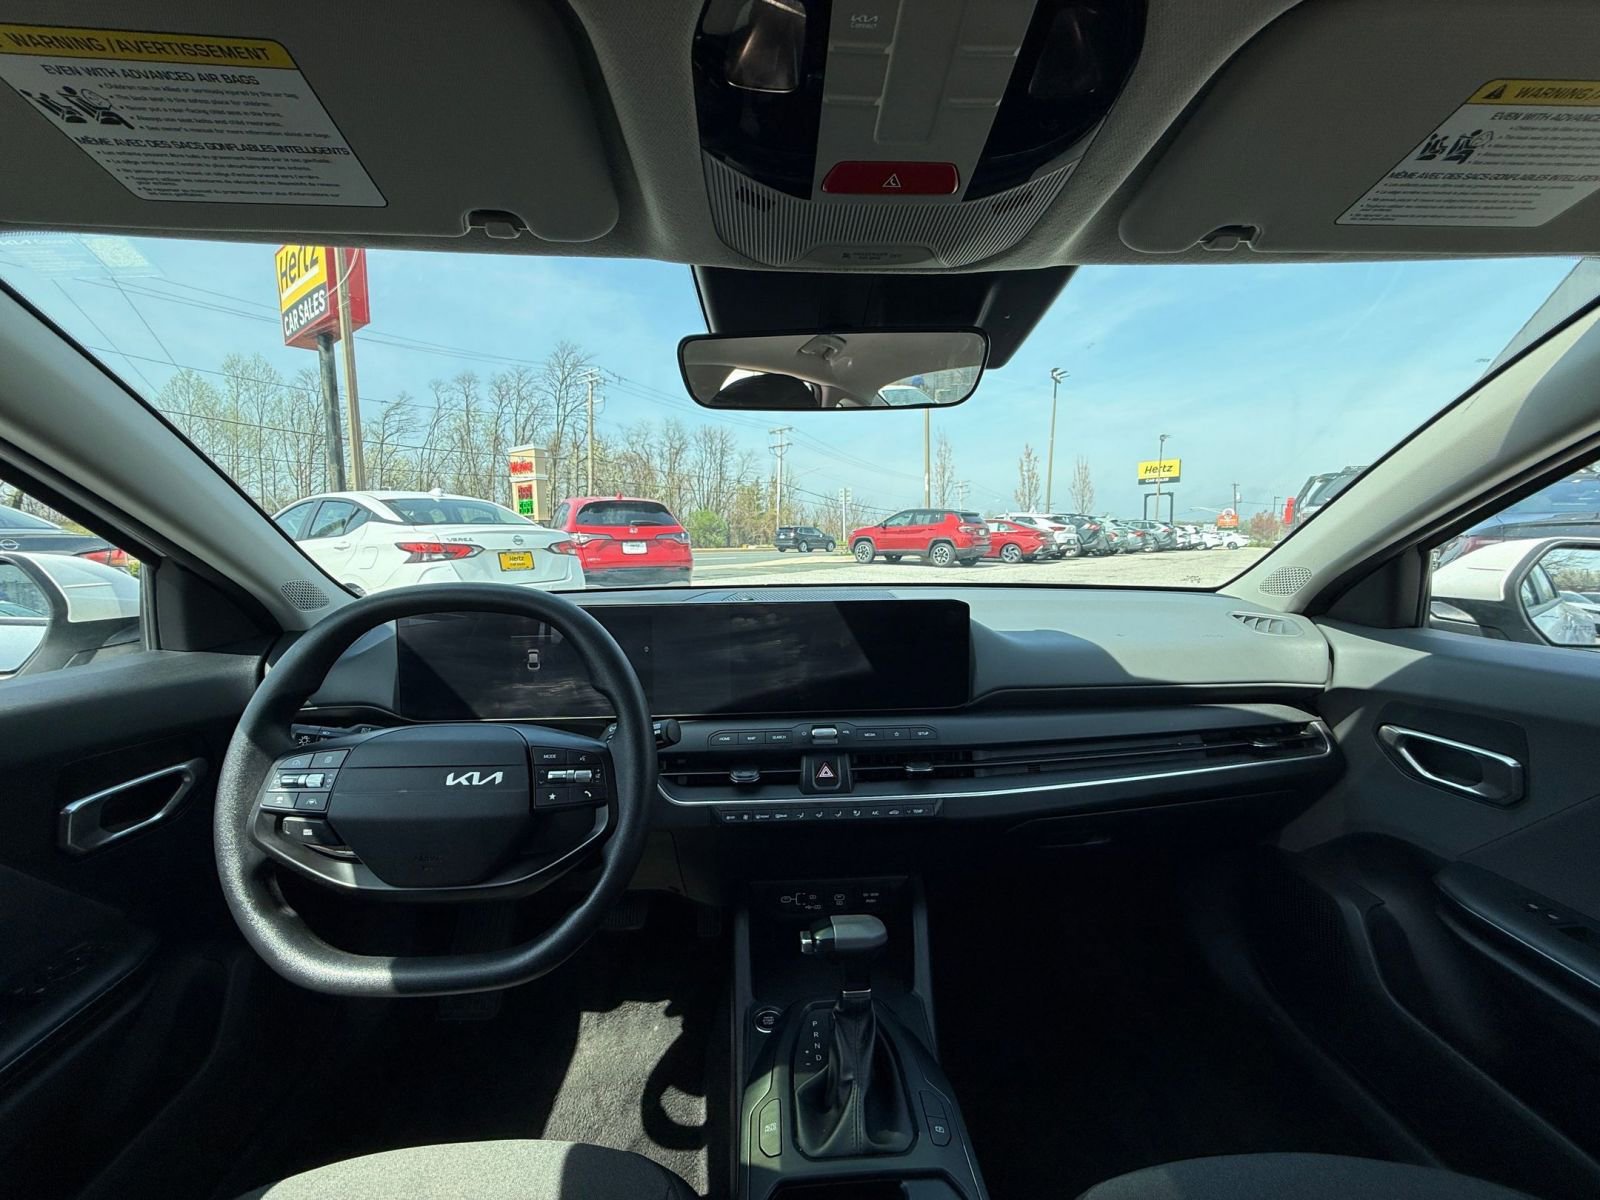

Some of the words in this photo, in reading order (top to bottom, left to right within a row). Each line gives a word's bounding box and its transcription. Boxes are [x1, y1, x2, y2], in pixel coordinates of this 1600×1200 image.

[3, 32, 106, 51] WARNING
[41, 64, 82, 76] EVEN
[81, 66, 120, 78] WITH
[120, 68, 195, 82] ADVANCED
[197, 72, 222, 83] AIR
[220, 73, 260, 85] BAGS
[1514, 86, 1594, 100] WARNING
[113, 138, 147, 148] AVEC
[145, 139, 172, 149] DES
[170, 140, 206, 151] SACS
[204, 142, 277, 153] GONFLABLES
[275, 144, 350, 156] INTELLIGENTS
[284, 311, 300, 336] CAR
[298, 289, 326, 327] SALES
[445, 771, 504, 786] KIA
